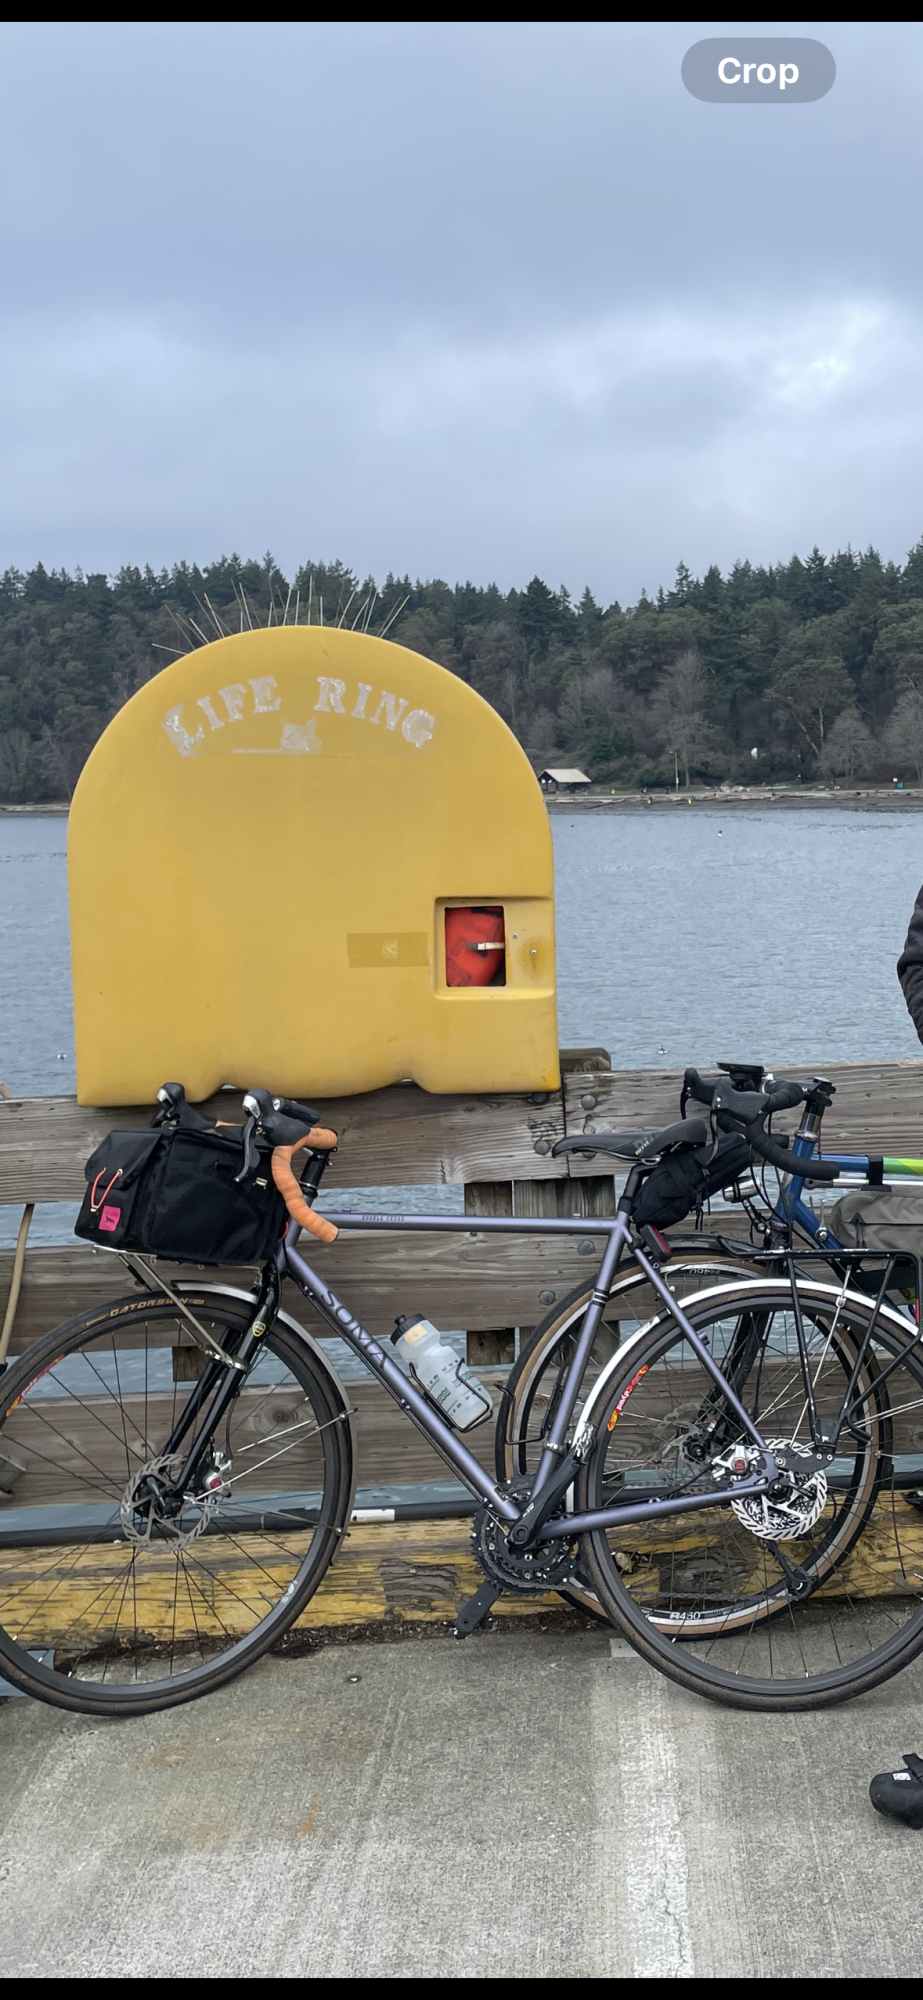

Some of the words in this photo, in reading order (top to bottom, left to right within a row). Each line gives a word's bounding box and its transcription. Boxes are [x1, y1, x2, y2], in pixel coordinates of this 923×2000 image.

[164, 676, 281, 749] LIFE
[314, 676, 435, 749] RING
[110, 1298, 189, 1317] GATORSKN
[321, 1290, 388, 1370] SOMA
